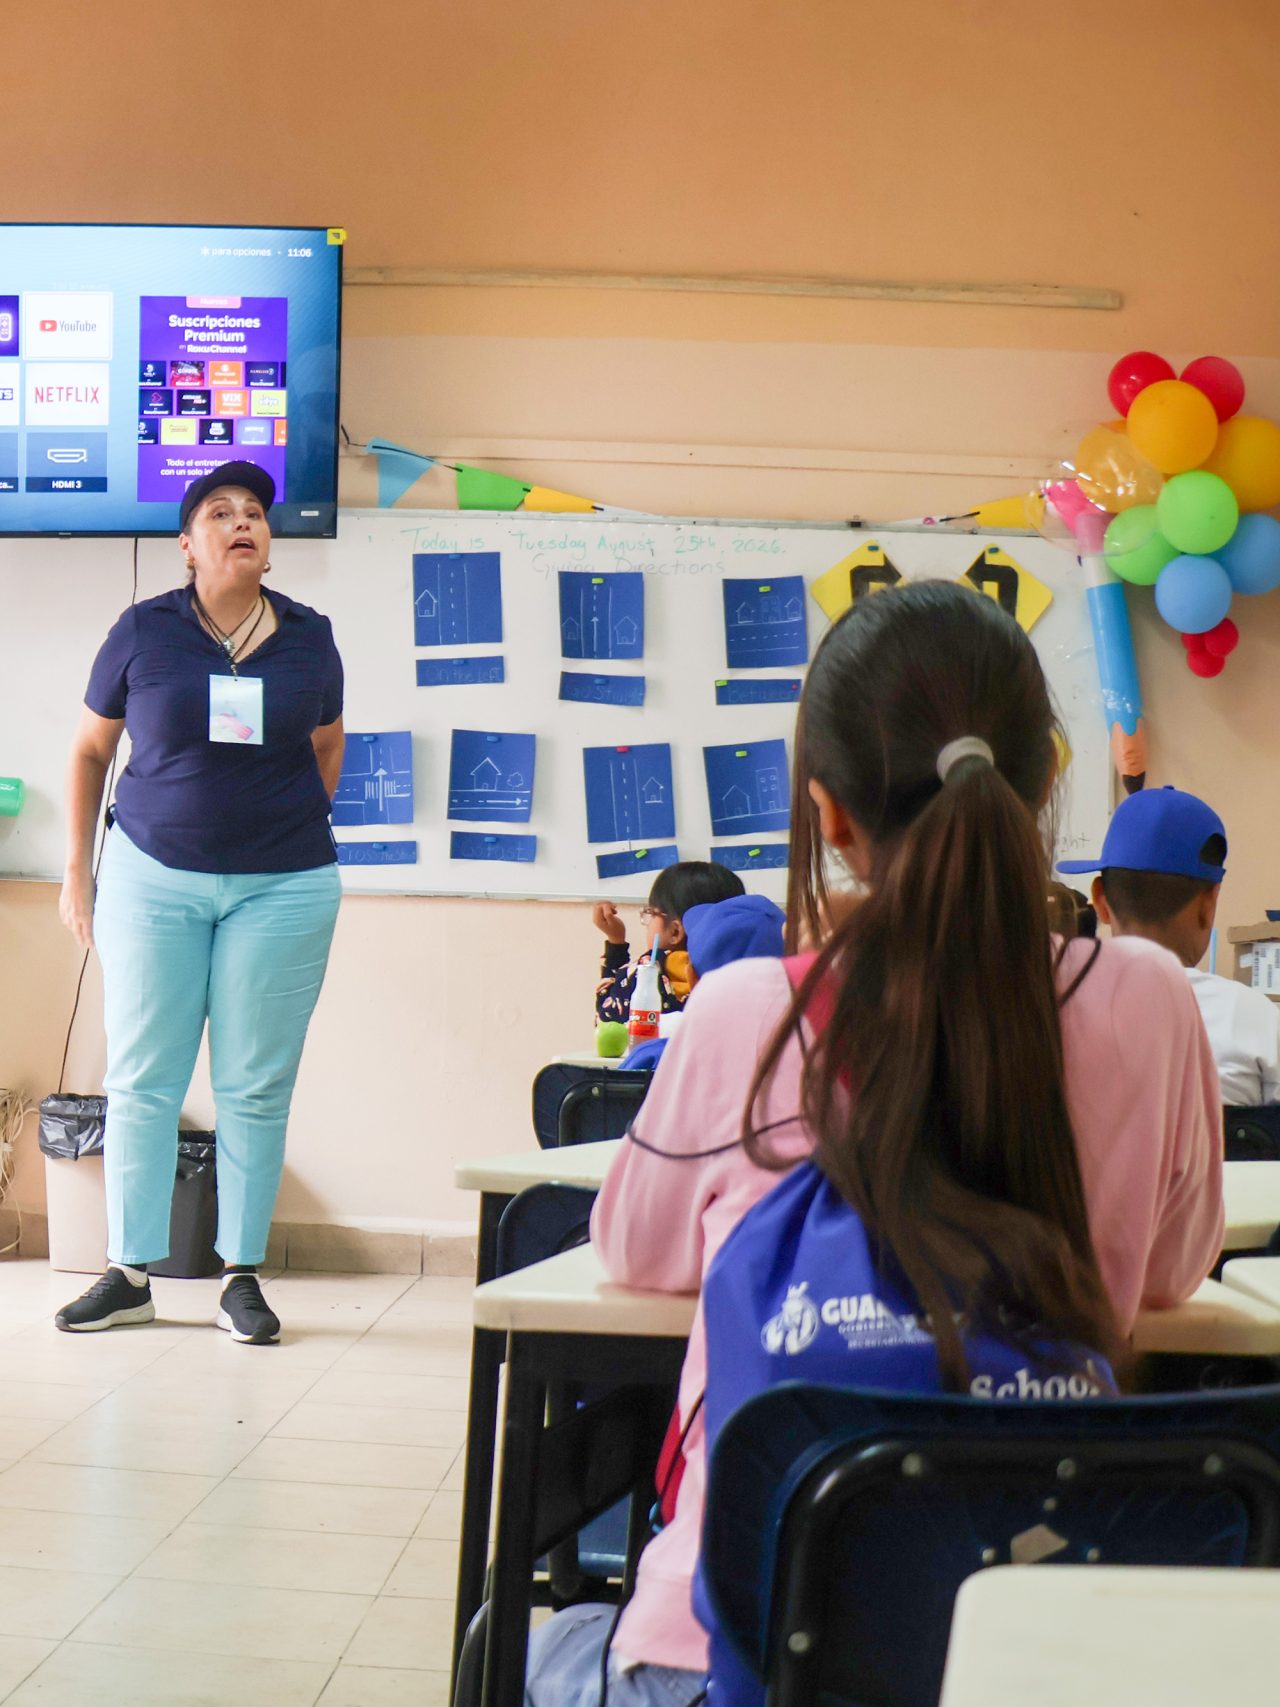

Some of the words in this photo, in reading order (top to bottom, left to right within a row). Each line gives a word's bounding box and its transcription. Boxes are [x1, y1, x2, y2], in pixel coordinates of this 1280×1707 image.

[211, 248, 232, 258] para
[233, 248, 271, 258] opciones
[59, 319, 97, 333] YouTube
[169, 314, 261, 330] Suscripciones
[184, 329, 245, 343] Premium
[34, 386, 100, 404] NETFLIX
[166, 459, 185, 467] Todo
[186, 459, 193, 467] el
[160, 468, 175, 476] con
[175, 468, 186, 476] un
[187, 468, 203, 476] solo
[51, 480, 75, 489] HDMI
[76, 480, 82, 489] 3
[400, 527, 458, 554] Today
[470, 534, 486, 550] is
[510, 532, 587, 561] Tuesday
[614, 555, 726, 575] Directions
